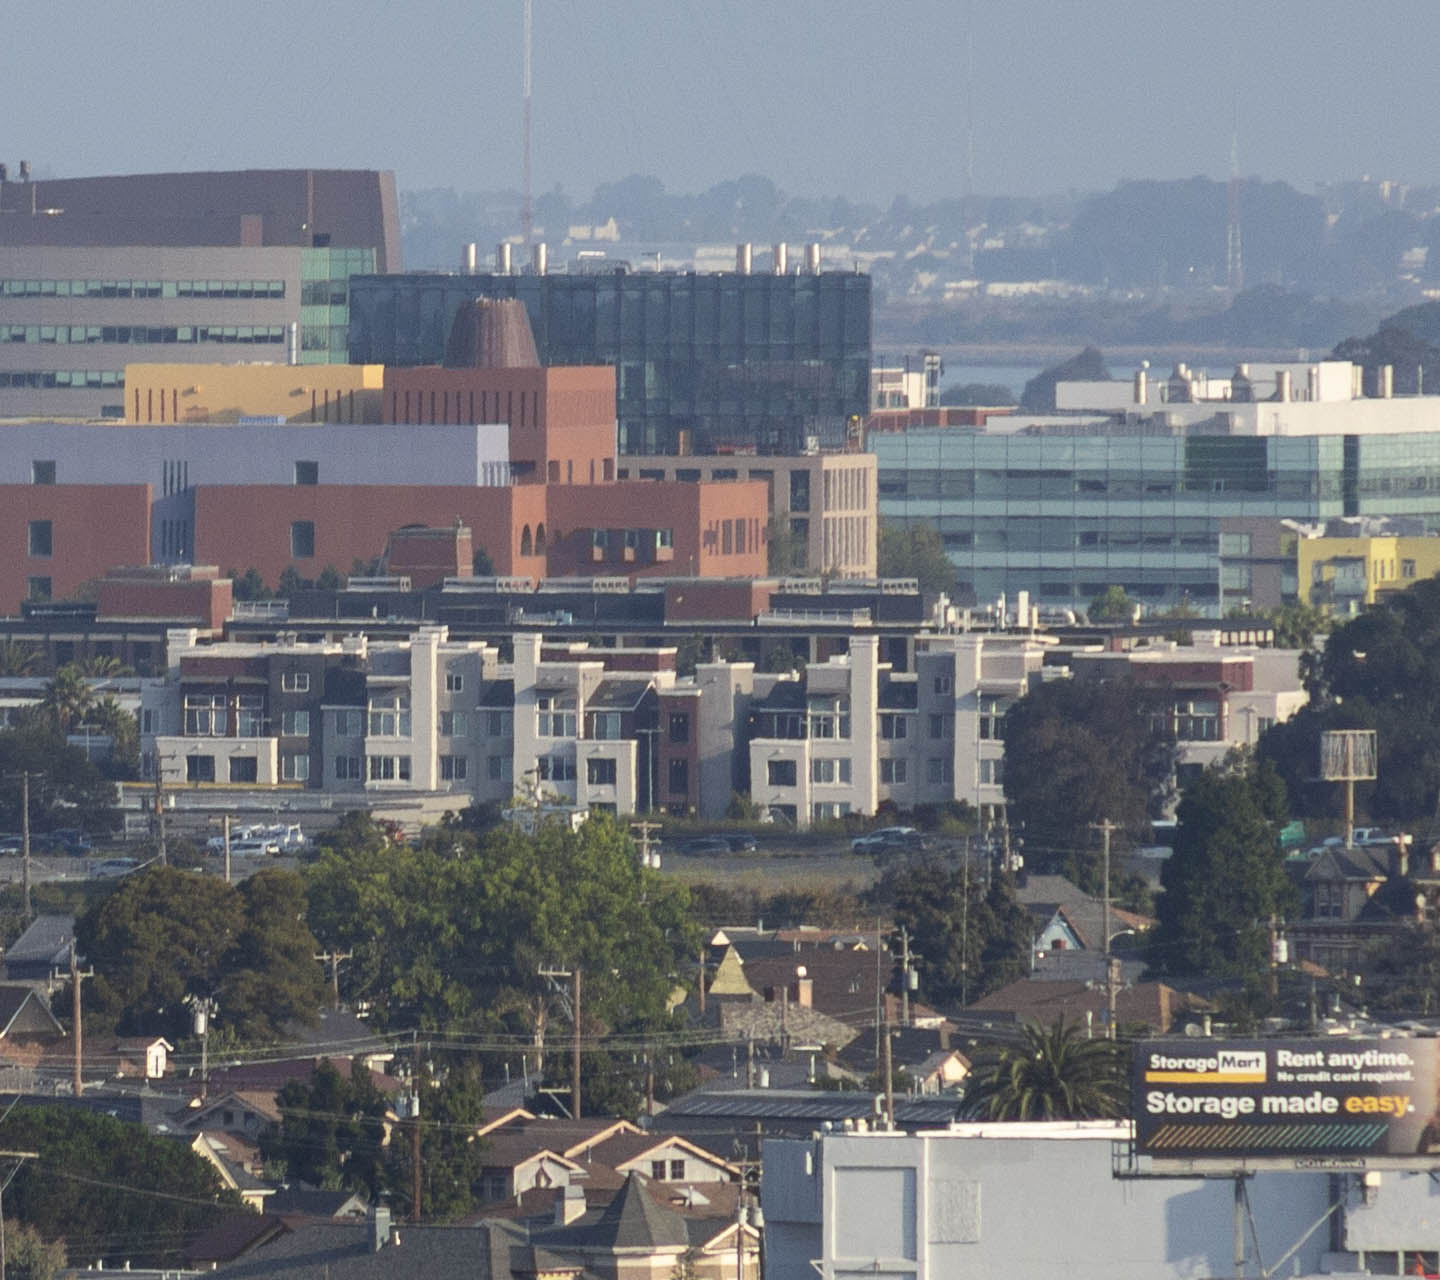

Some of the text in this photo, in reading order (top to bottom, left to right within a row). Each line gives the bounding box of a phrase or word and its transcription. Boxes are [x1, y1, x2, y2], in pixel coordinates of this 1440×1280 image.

[1277, 1050, 1414, 1069] Rent anytime.
[1277, 1071, 1414, 1083] No credit card required.
[1146, 1091, 1415, 1118] Storage made easy.
